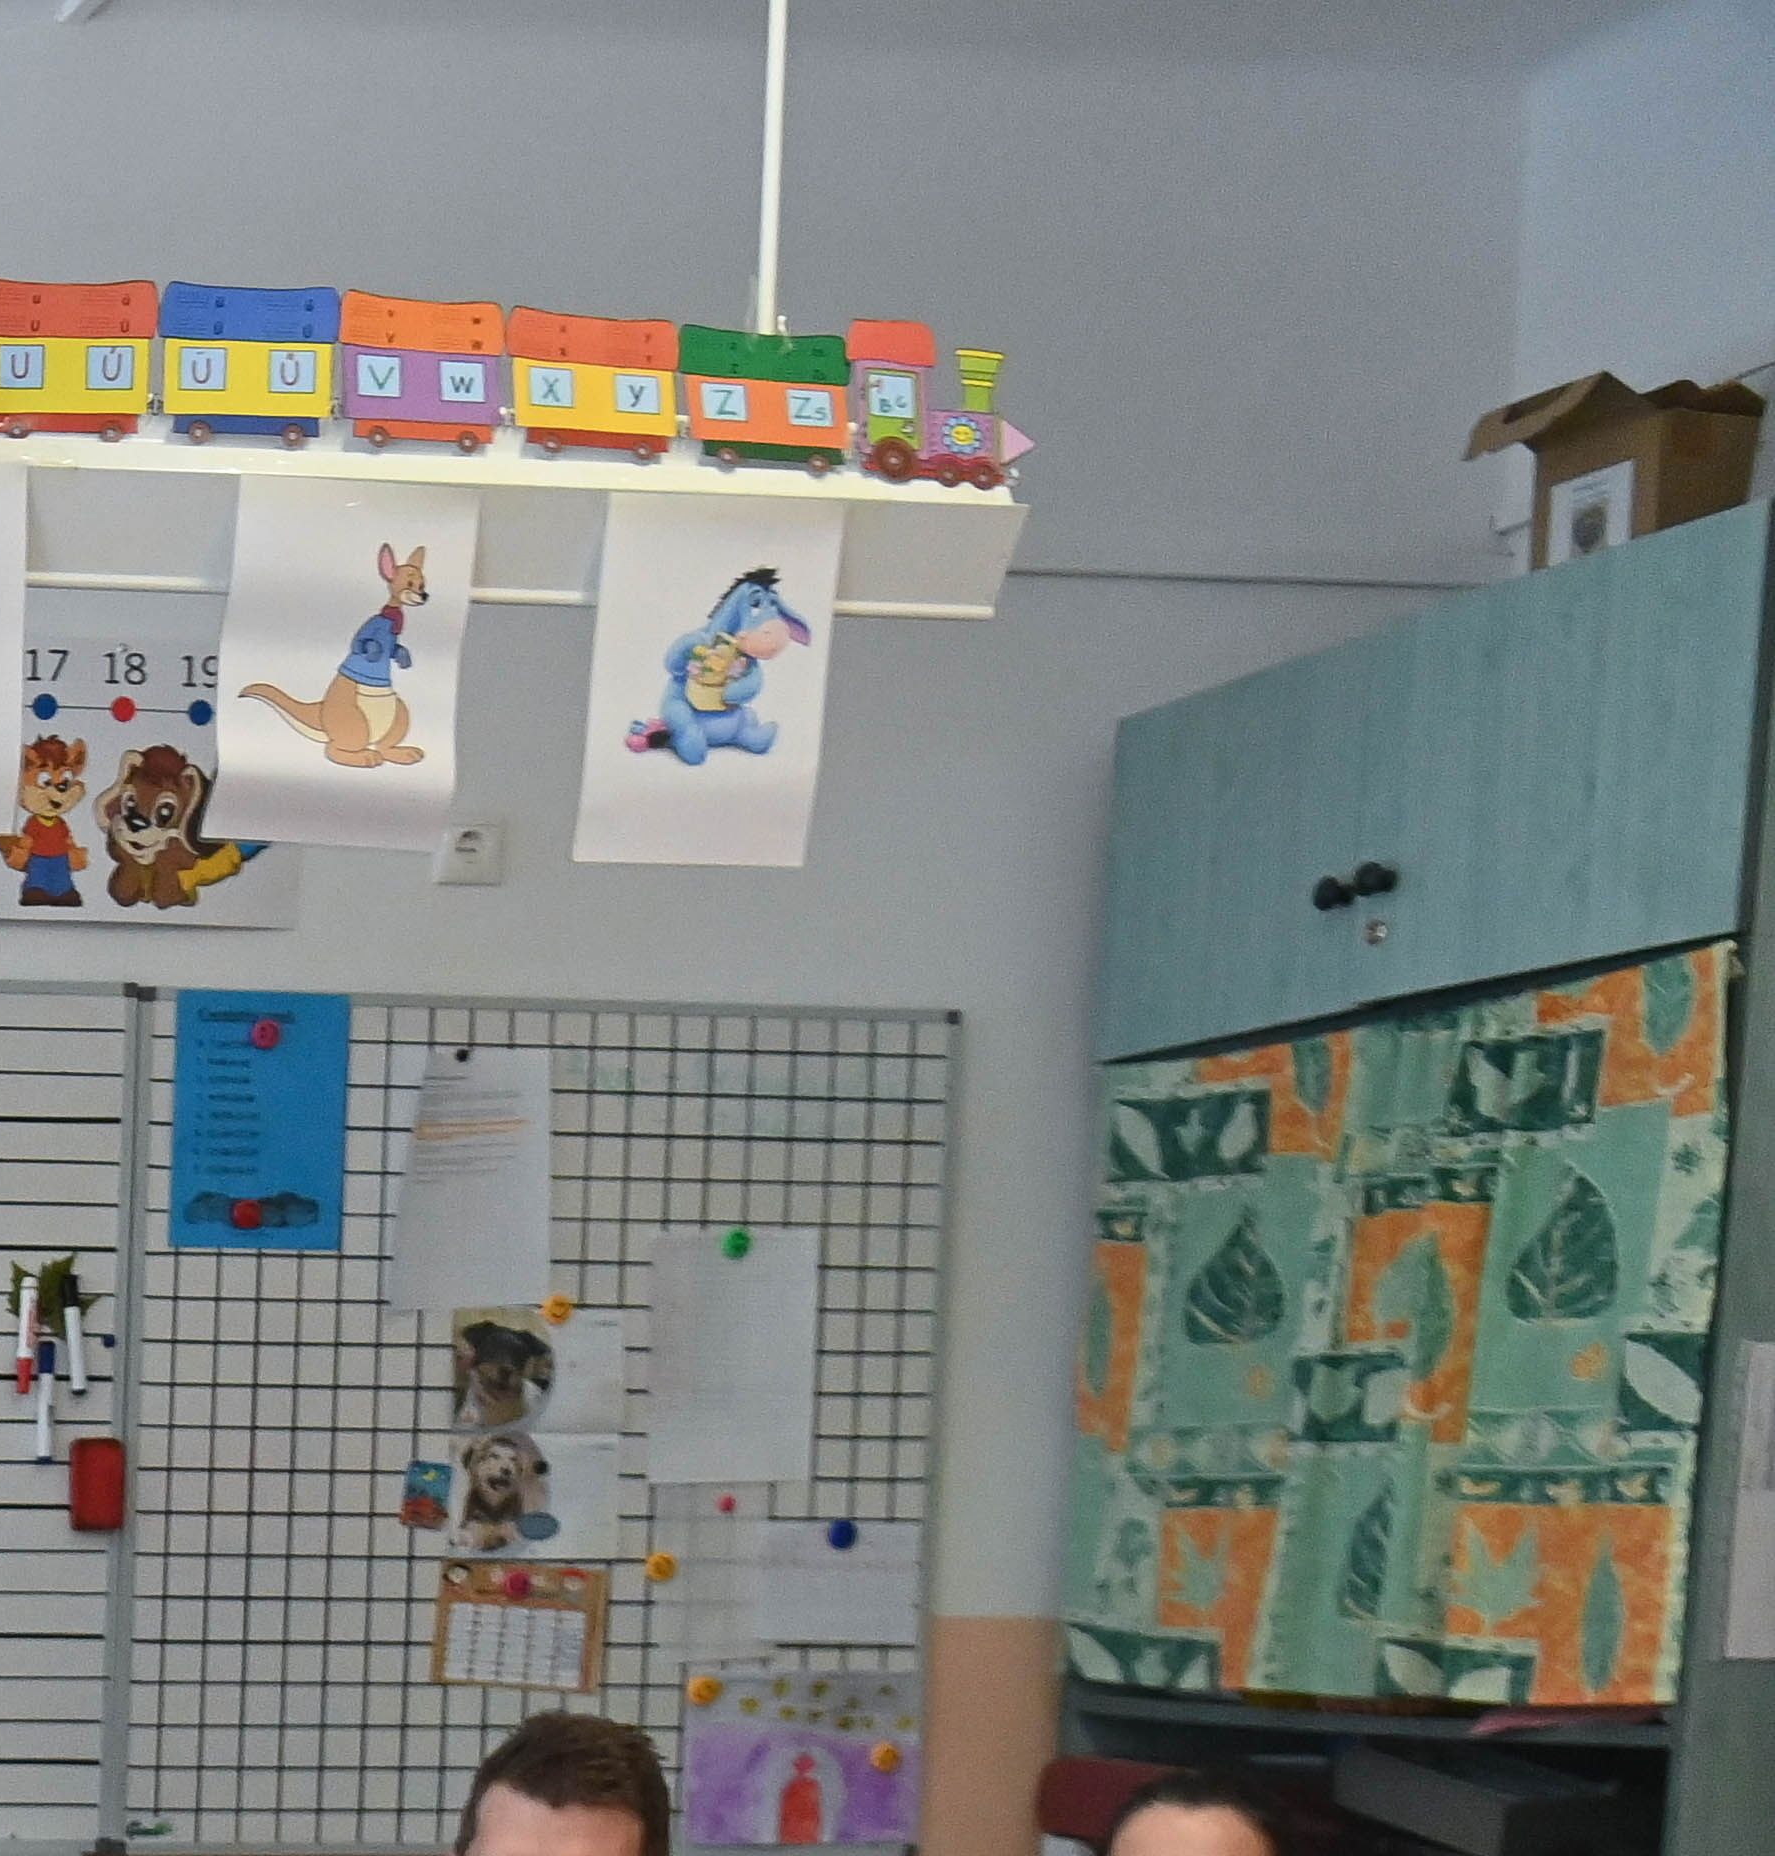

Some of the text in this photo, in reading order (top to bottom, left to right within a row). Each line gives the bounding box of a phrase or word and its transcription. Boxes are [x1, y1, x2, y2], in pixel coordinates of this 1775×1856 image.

[11, 352, 29, 379] U
[368, 365, 395, 390] V
[714, 390, 737, 415] Z
[791, 396, 826, 421] Zs
[27, 649, 68, 681] 17
[105, 653, 146, 685] 18
